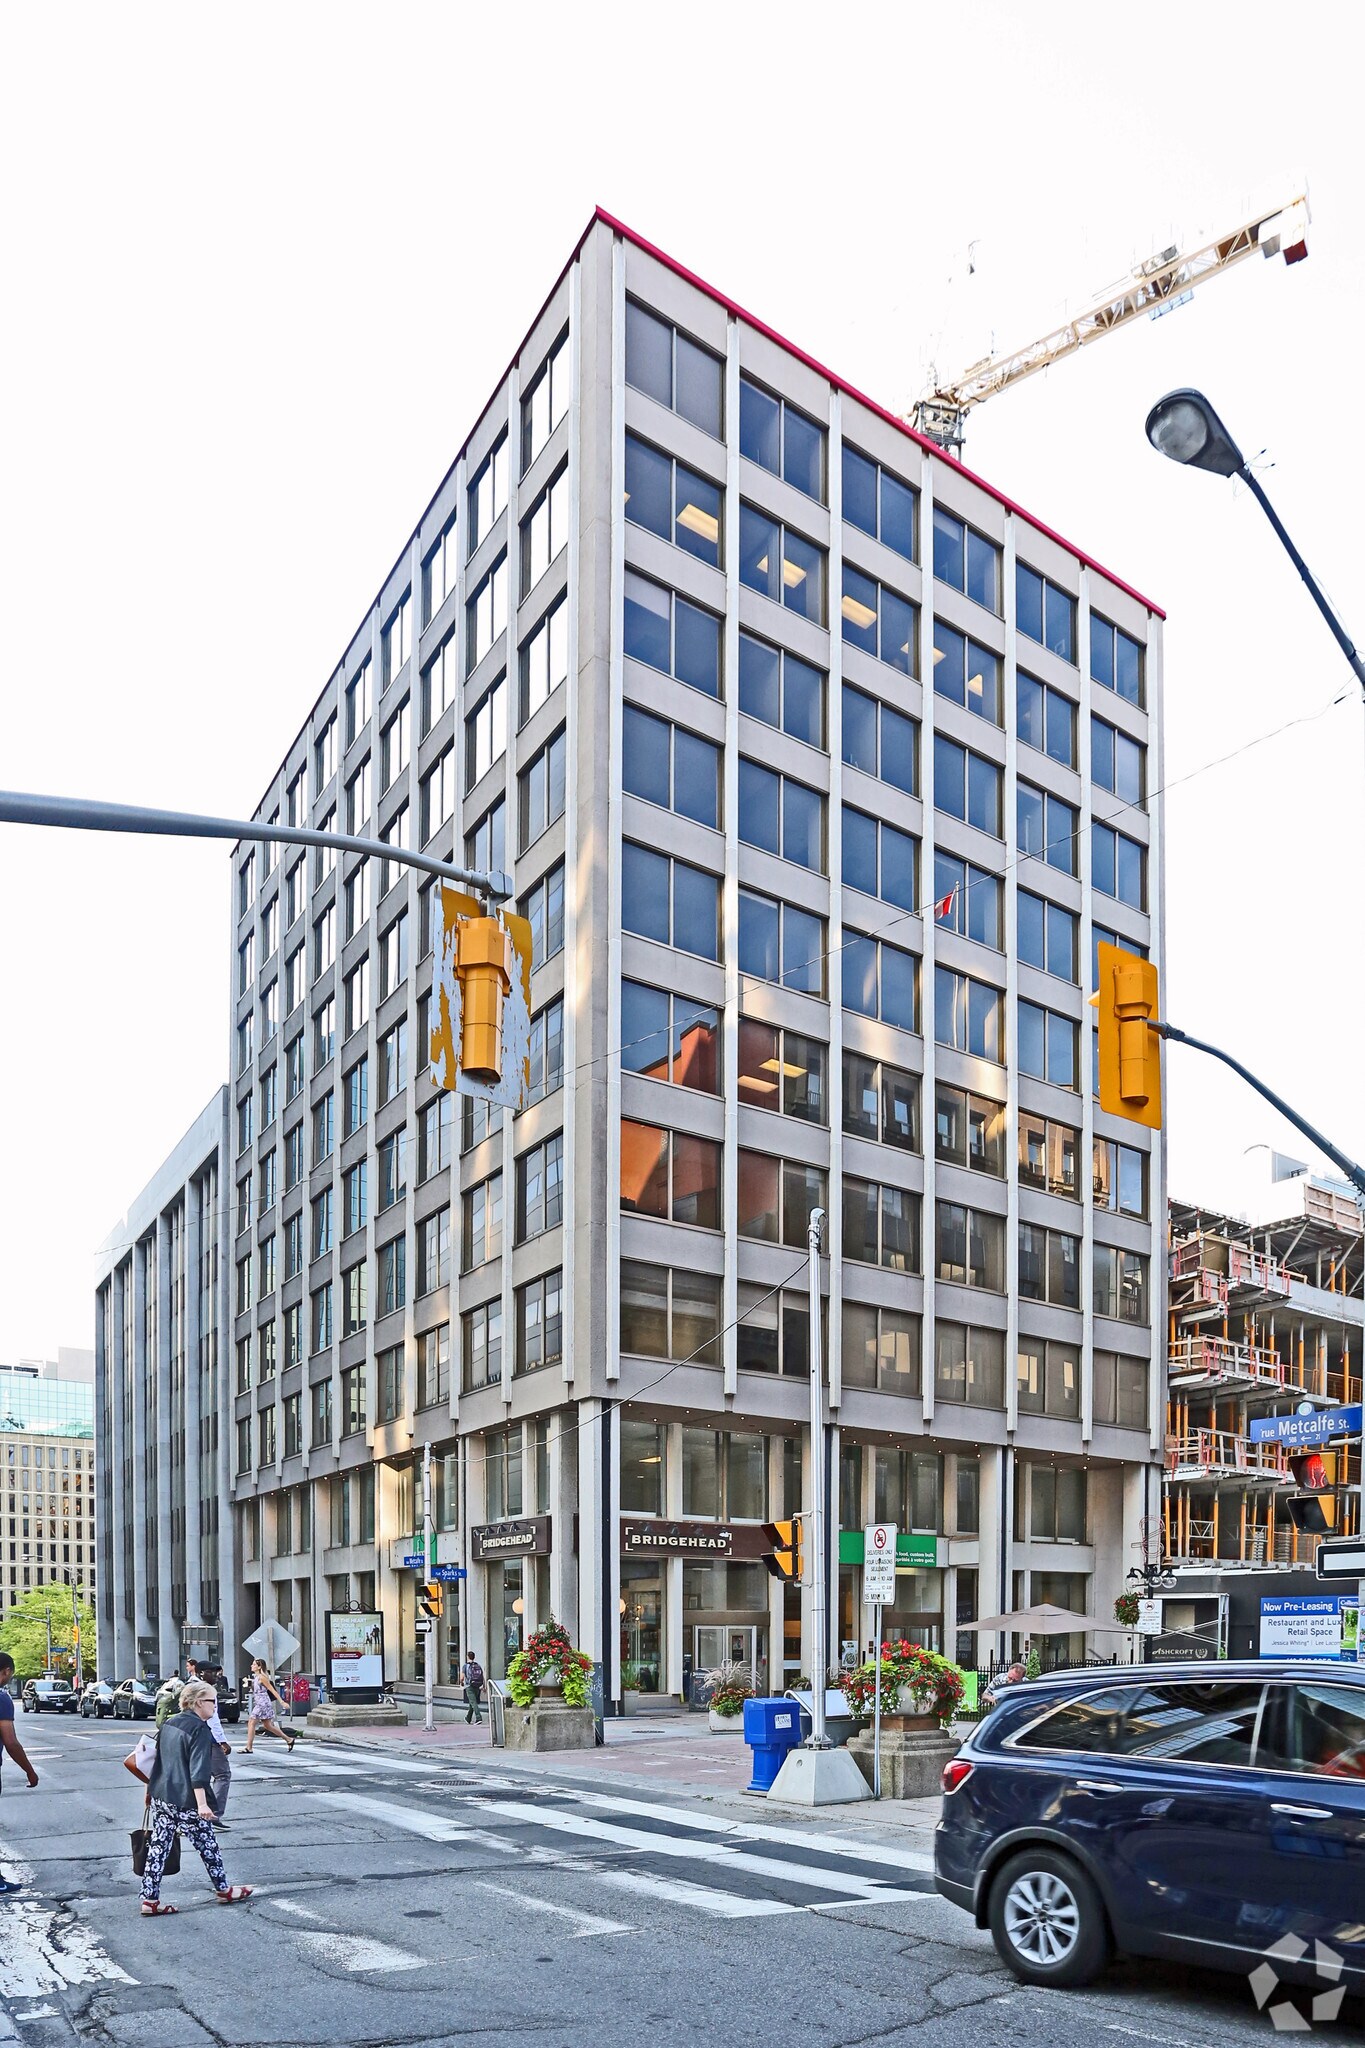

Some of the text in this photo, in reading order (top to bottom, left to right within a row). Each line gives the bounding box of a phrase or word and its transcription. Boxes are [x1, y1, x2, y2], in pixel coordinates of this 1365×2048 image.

[1278, 1415, 1334, 1436] Metcalfe
[1338, 1419, 1350, 1429] St.
[482, 1534, 532, 1548] BRIDGEHEAD
[632, 1534, 727, 1548] BRIDGEHEAD
[442, 1570, 457, 1578] Sparks
[1264, 1603, 1282, 1612] Now
[1284, 1602, 1333, 1612] Pre-Leasing
[1311, 1629, 1333, 1637] Space
